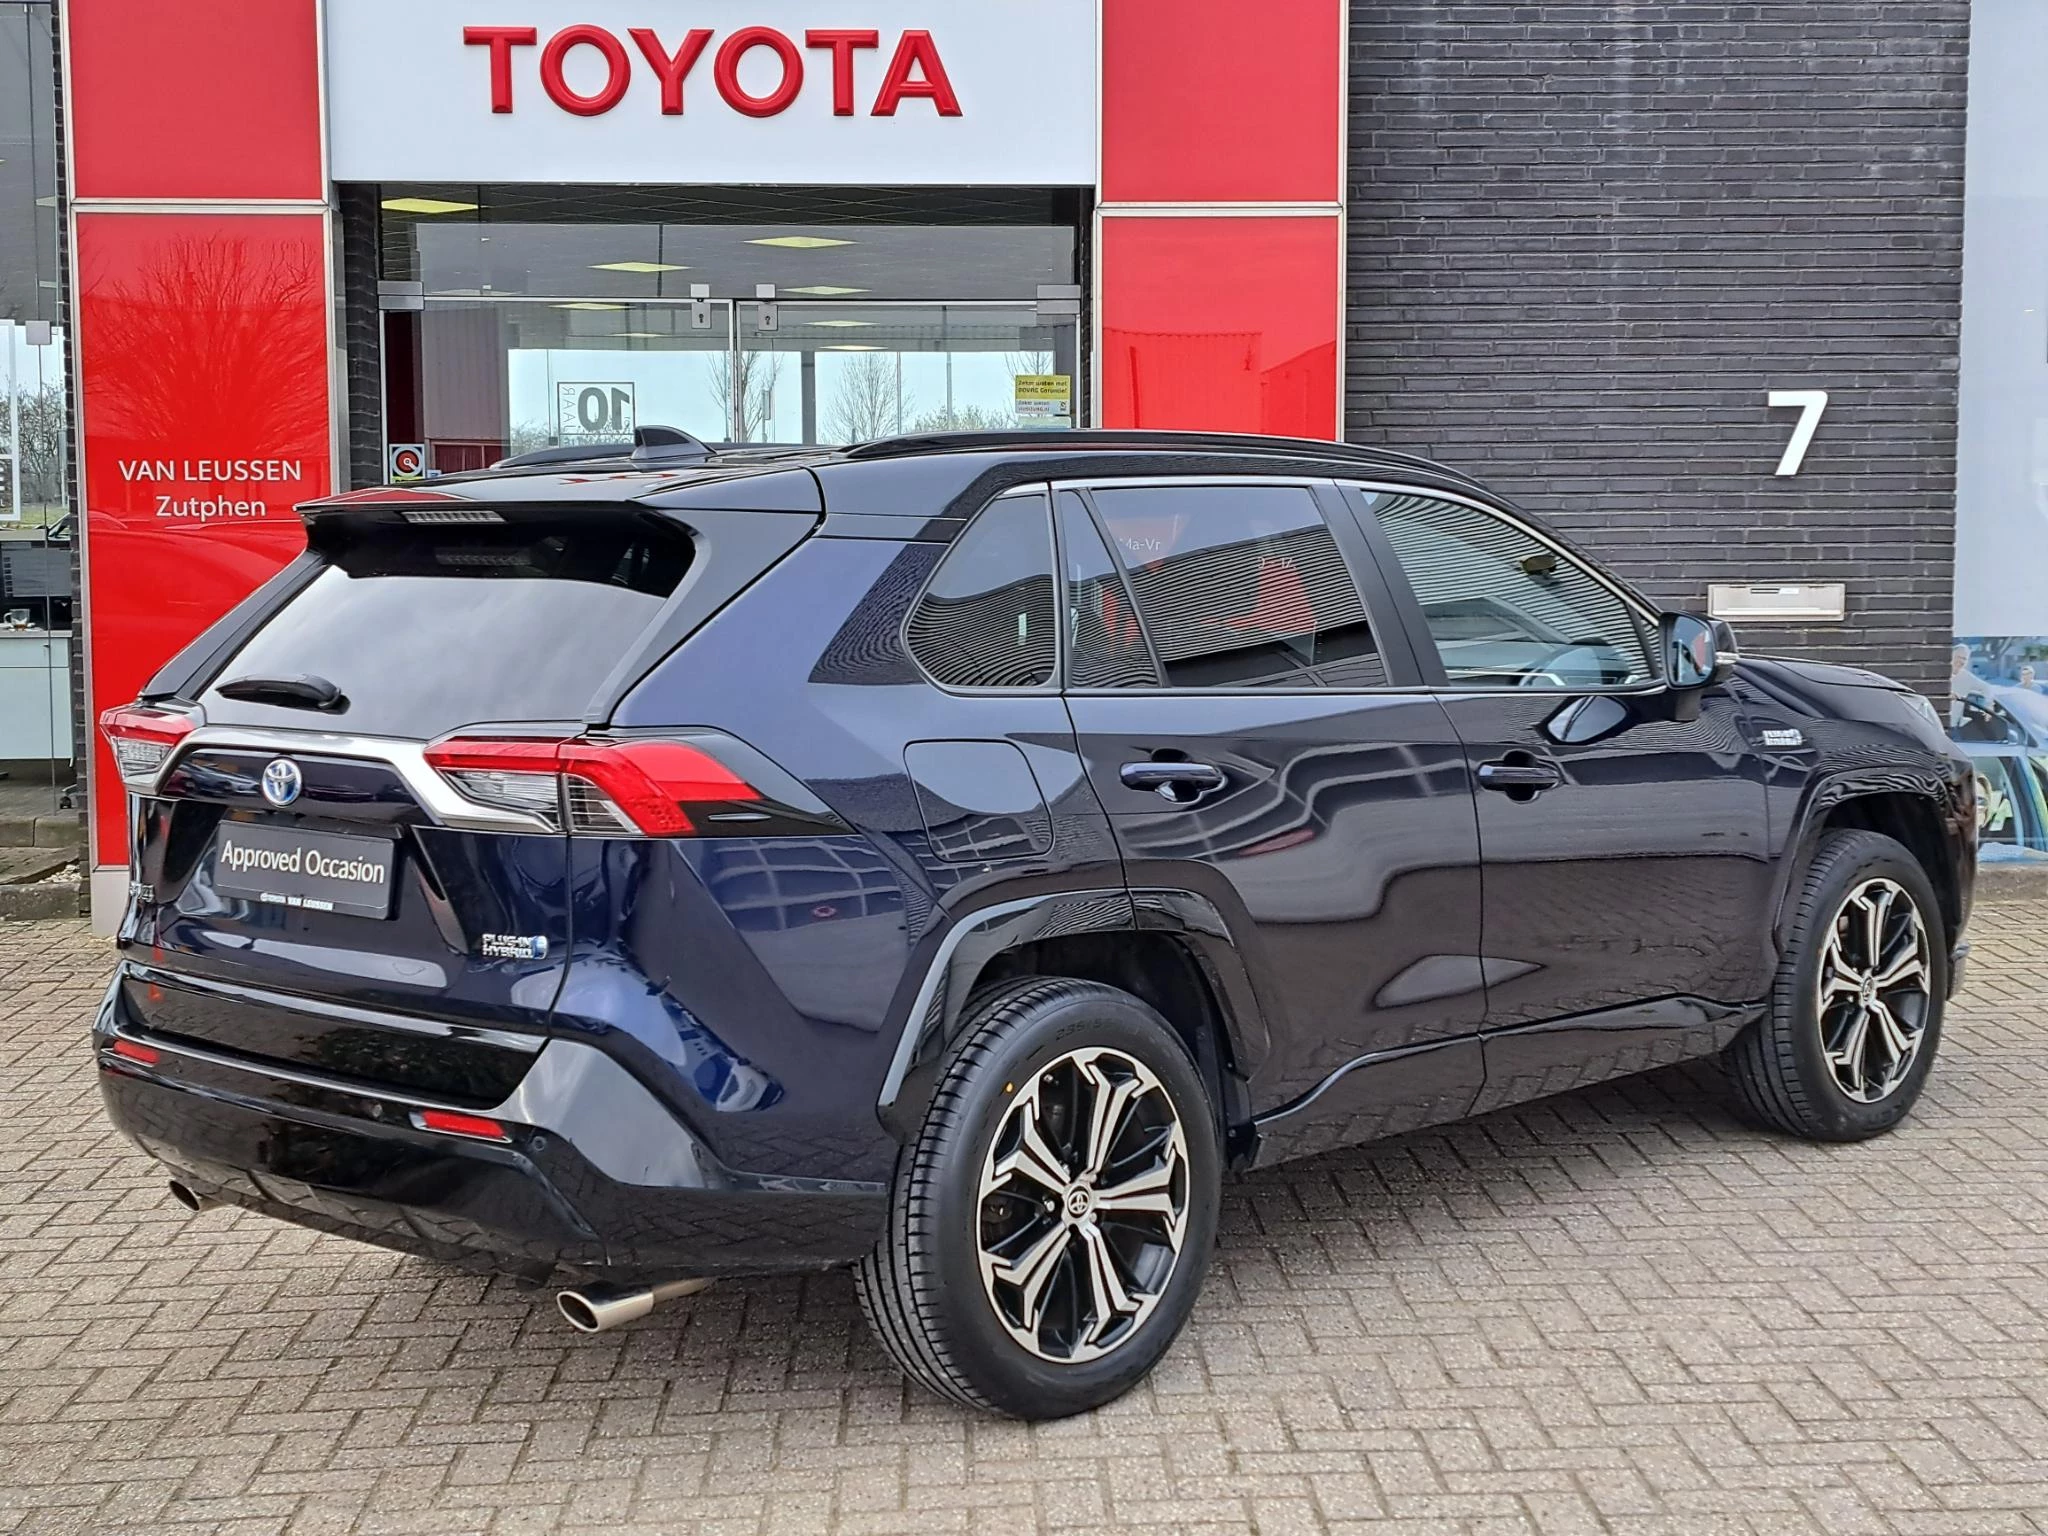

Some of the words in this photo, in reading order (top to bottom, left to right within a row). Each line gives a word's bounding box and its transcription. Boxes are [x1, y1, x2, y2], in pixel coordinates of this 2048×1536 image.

[462, 23, 964, 118] TOYOTA
[1768, 390, 1828, 476] 7
[118, 459, 175, 482] VAN
[184, 459, 301, 482] LEUSSEN
[155, 494, 266, 522] Zutphen
[220, 839, 301, 873] Approved
[305, 849, 385, 884] Occasion
[482, 944, 534, 958] HYBRID
